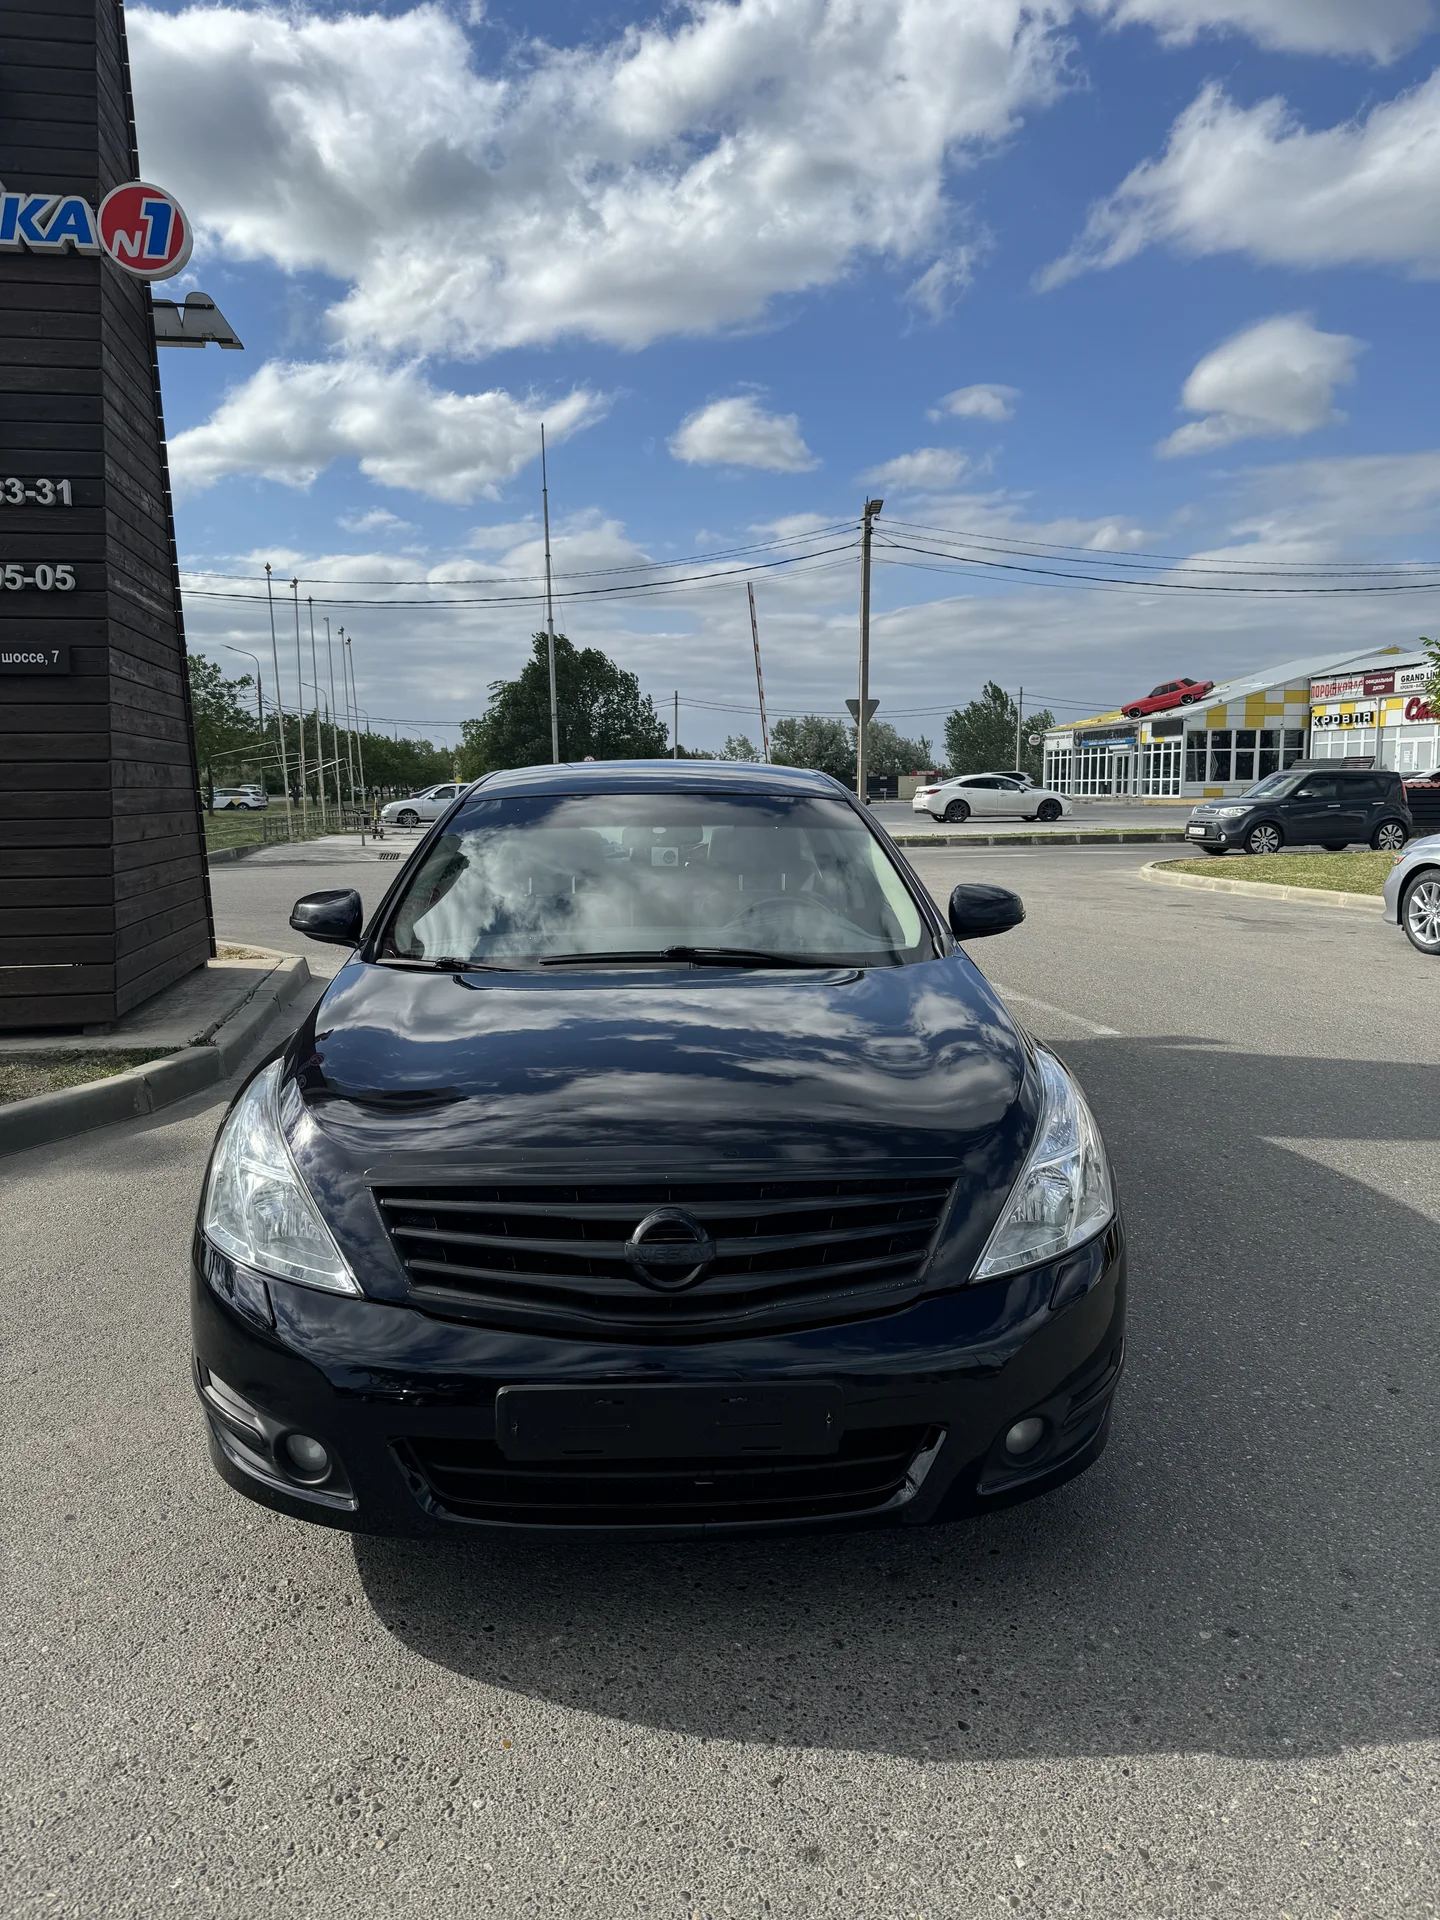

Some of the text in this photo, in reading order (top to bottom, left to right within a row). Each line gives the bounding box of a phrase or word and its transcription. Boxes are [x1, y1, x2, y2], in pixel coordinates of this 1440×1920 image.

[0, 478, 73, 506] 3-31
[0, 565, 75, 591] 5-05
[1, 650, 60, 665] шоссе, 7
[1400, 670, 1439, 683] GRAND LIN
[1313, 712, 1371, 726] КРОВЛЯ
[635, 1247, 707, 1261] NISSAN
